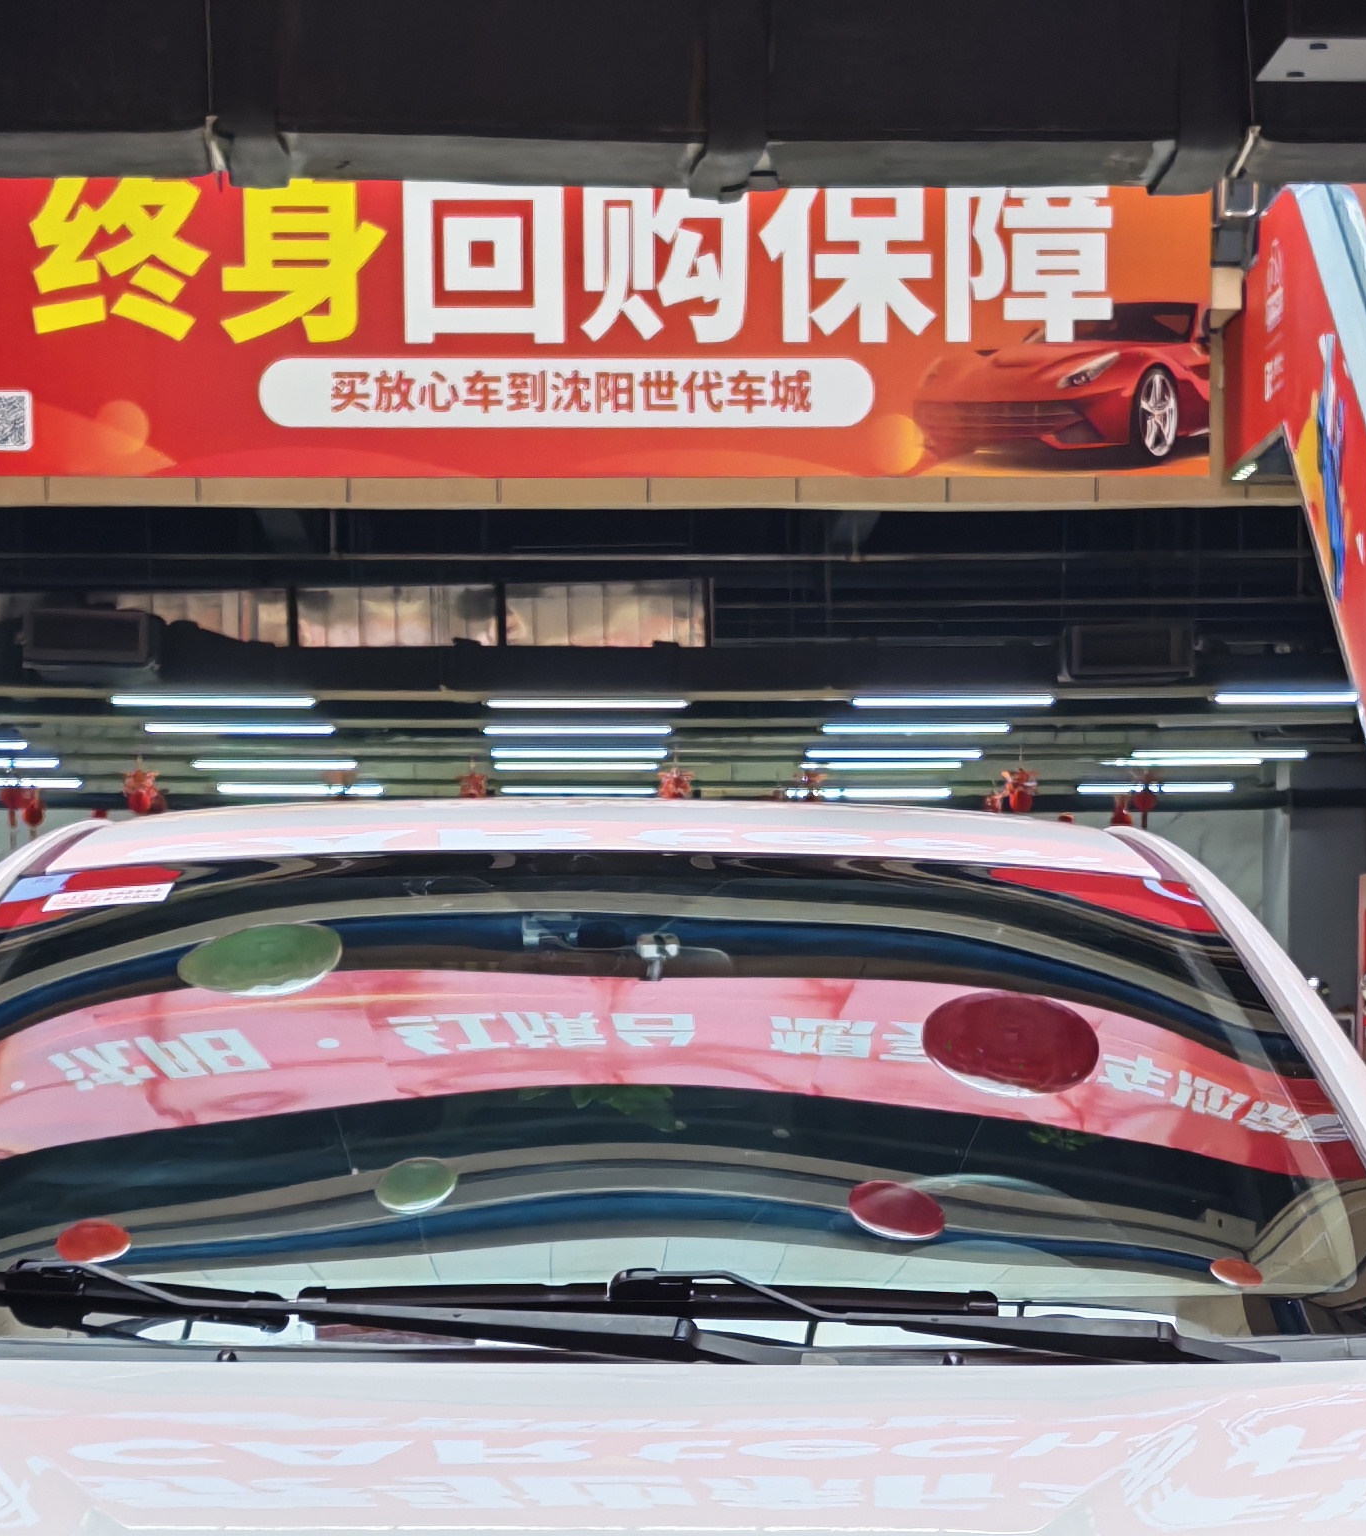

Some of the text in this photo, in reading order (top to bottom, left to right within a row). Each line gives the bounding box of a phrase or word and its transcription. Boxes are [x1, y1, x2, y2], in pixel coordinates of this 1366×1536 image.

[30, 178, 1113, 344] 终身回购保障
[330, 369, 812, 414] 买放心车到沈阳世代车城
